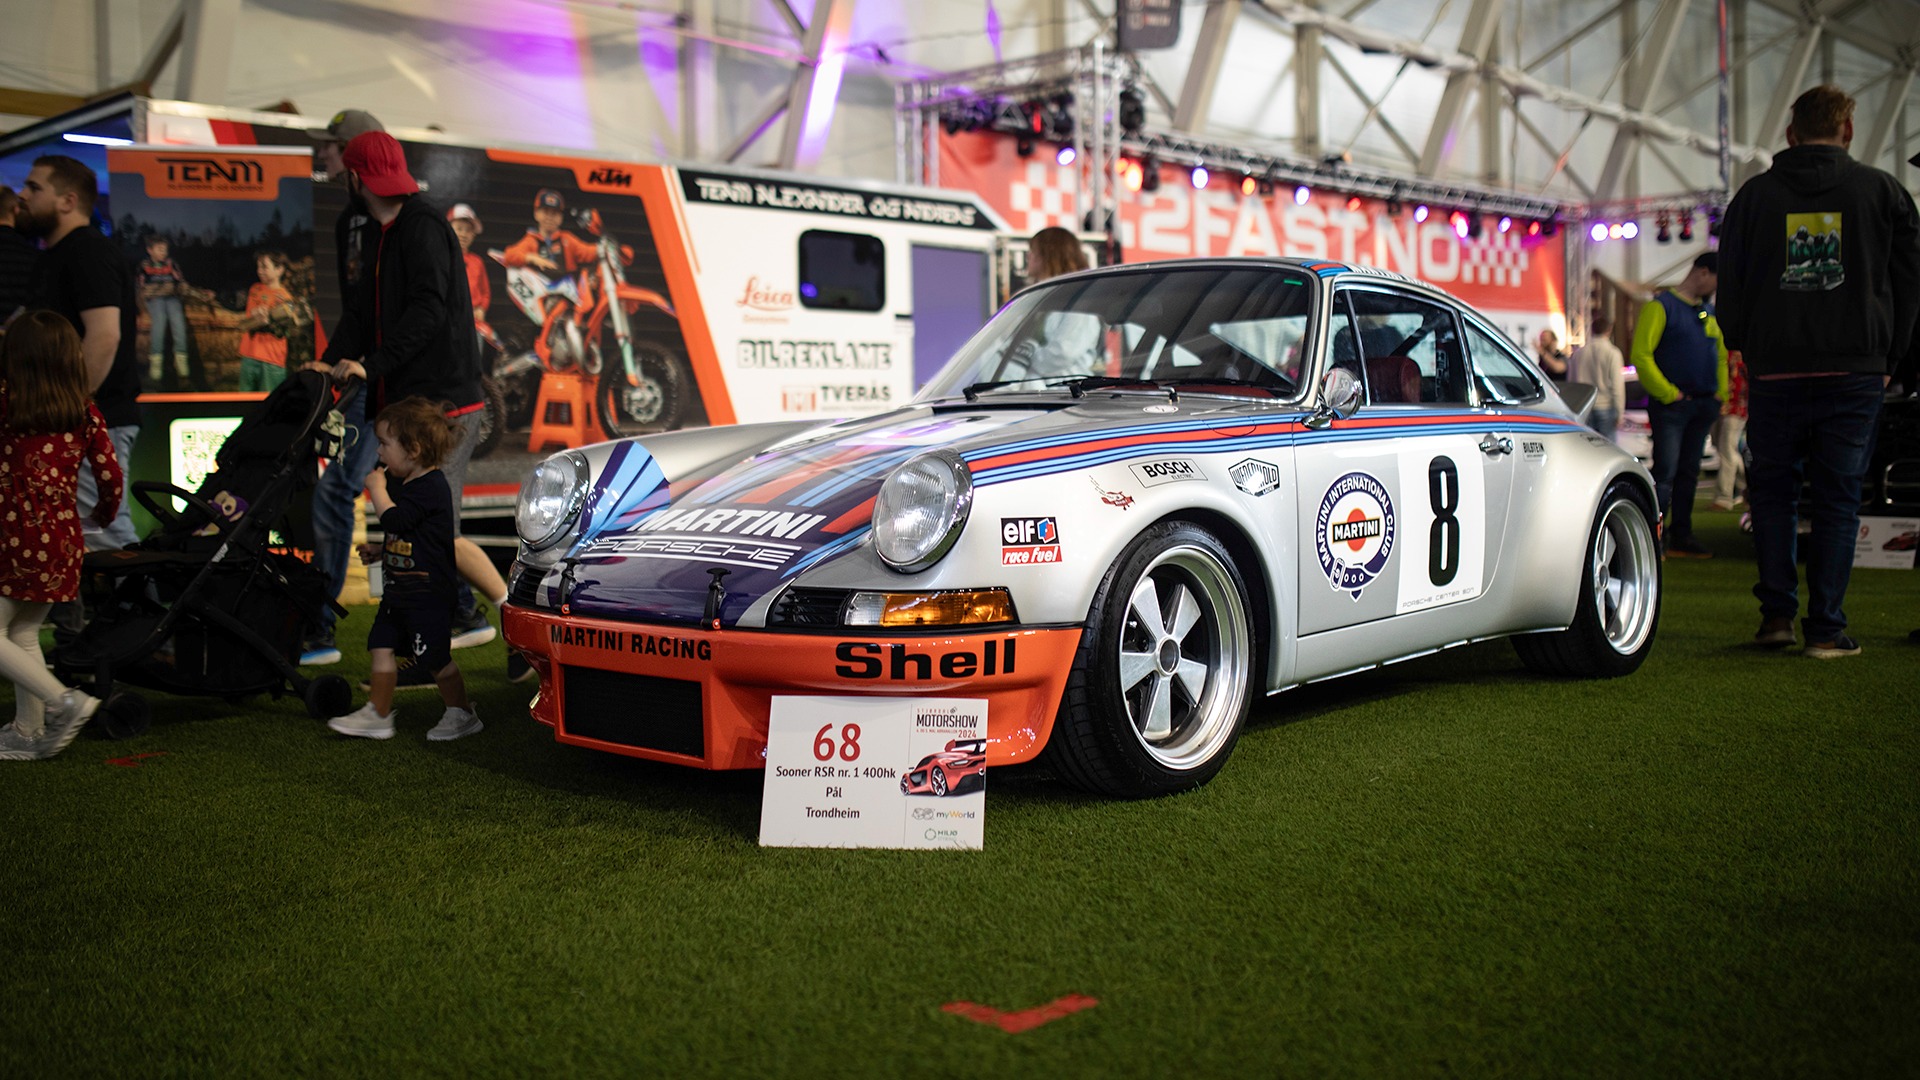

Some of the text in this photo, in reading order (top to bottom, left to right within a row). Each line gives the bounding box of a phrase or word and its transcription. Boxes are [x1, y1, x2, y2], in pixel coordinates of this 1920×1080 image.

[157, 157, 264, 183] TEAM
[588, 168, 632, 187] KTM
[694, 177, 753, 204] TEAM
[754, 183, 867, 215] ALEXANDER
[869, 196, 901, 218] OG
[735, 276, 794, 311] Leica
[738, 339, 892, 369] BILREKLAME
[820, 379, 891, 402] TVERÅS
[1522, 441, 1545, 453] BILSTEIN
[1142, 461, 1194, 478] BOSCH
[627, 509, 827, 539] MARTINI
[1003, 519, 1036, 544] elf
[1317, 477, 1395, 568] MARTINI INTERNATIONAL CLUB
[1334, 519, 1379, 541] MARTINI
[1428, 455, 1460, 587] 8
[588, 540, 794, 564] PORSCHE
[1003, 546, 1059, 564] race fuel
[1402, 596, 1433, 608] PORSCHE
[551, 624, 712, 661] MARTINI RACING
[835, 638, 1016, 680] Shell
[916, 714, 978, 728] MOTORSHOW
[813, 723, 861, 762] 68
[958, 730, 977, 738] 2024
[776, 765, 896, 778] Sooner RSR nr. 1 400hk
[826, 786, 842, 798] Pål
[806, 806, 860, 819] Trondheim
[936, 810, 975, 819] myWorld
